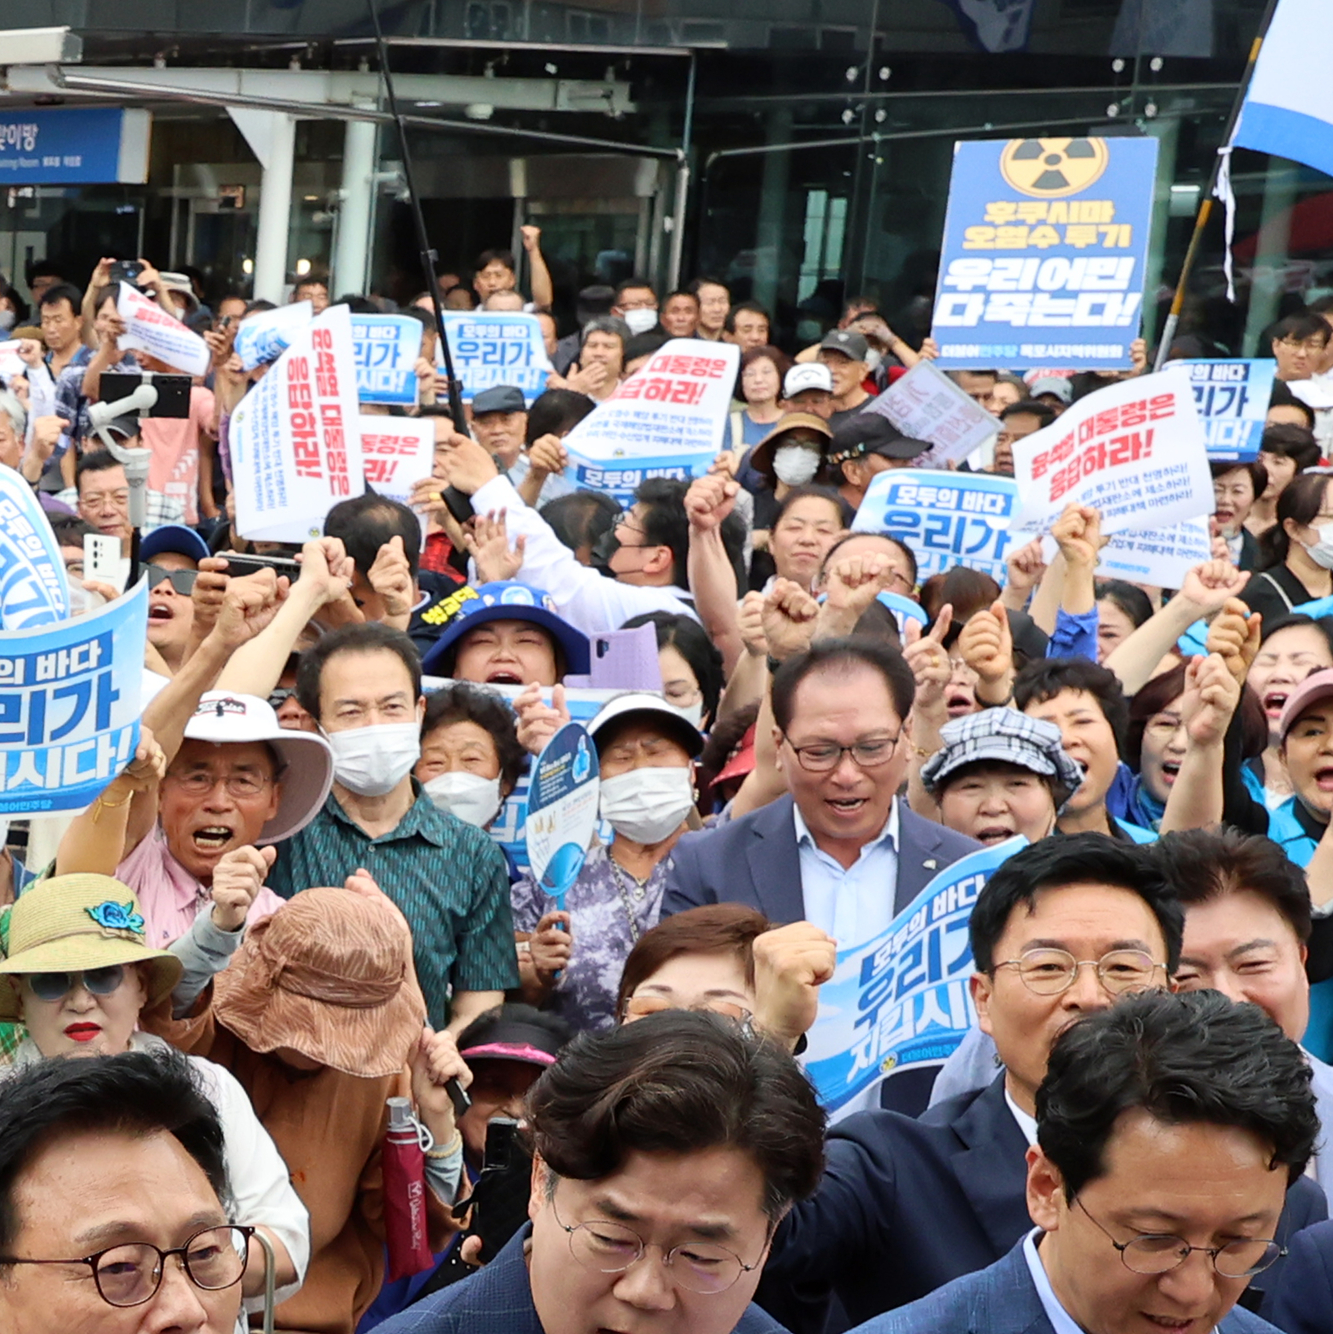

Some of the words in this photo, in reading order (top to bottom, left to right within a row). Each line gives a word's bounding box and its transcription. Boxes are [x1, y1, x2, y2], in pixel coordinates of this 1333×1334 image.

[984, 200, 1115, 225] 후쿠시마
[962, 225, 1061, 250] 오염수
[1064, 224, 1133, 248] 투기
[461, 325, 499, 338] 모두의
[501, 324, 530, 338] 바다
[311, 328, 341, 398] 윤석열
[455, 340, 534, 366] 우리가
[647, 354, 728, 379] 대통령은
[1220, 364, 1247, 382] 바다
[286, 356, 324, 479] 응답하라!
[1077, 392, 1177, 448] 대통령은
[319, 403, 351, 497] 대통령은
[584, 470, 640, 488] 모두의
[1048, 428, 1156, 503] 응답하라!
[1094, 482, 1118, 497] 투기
[1119, 477, 1141, 493] 반대
[1142, 462, 1190, 489] 천명하라!
[1144, 475, 1192, 499] 제소하라!
[895, 486, 957, 511] 모두의
[962, 488, 1006, 514] 바다
[1148, 488, 1193, 512] 마련하라!
[883, 510, 1012, 560] 우리가
[35, 639, 102, 681] 바다
